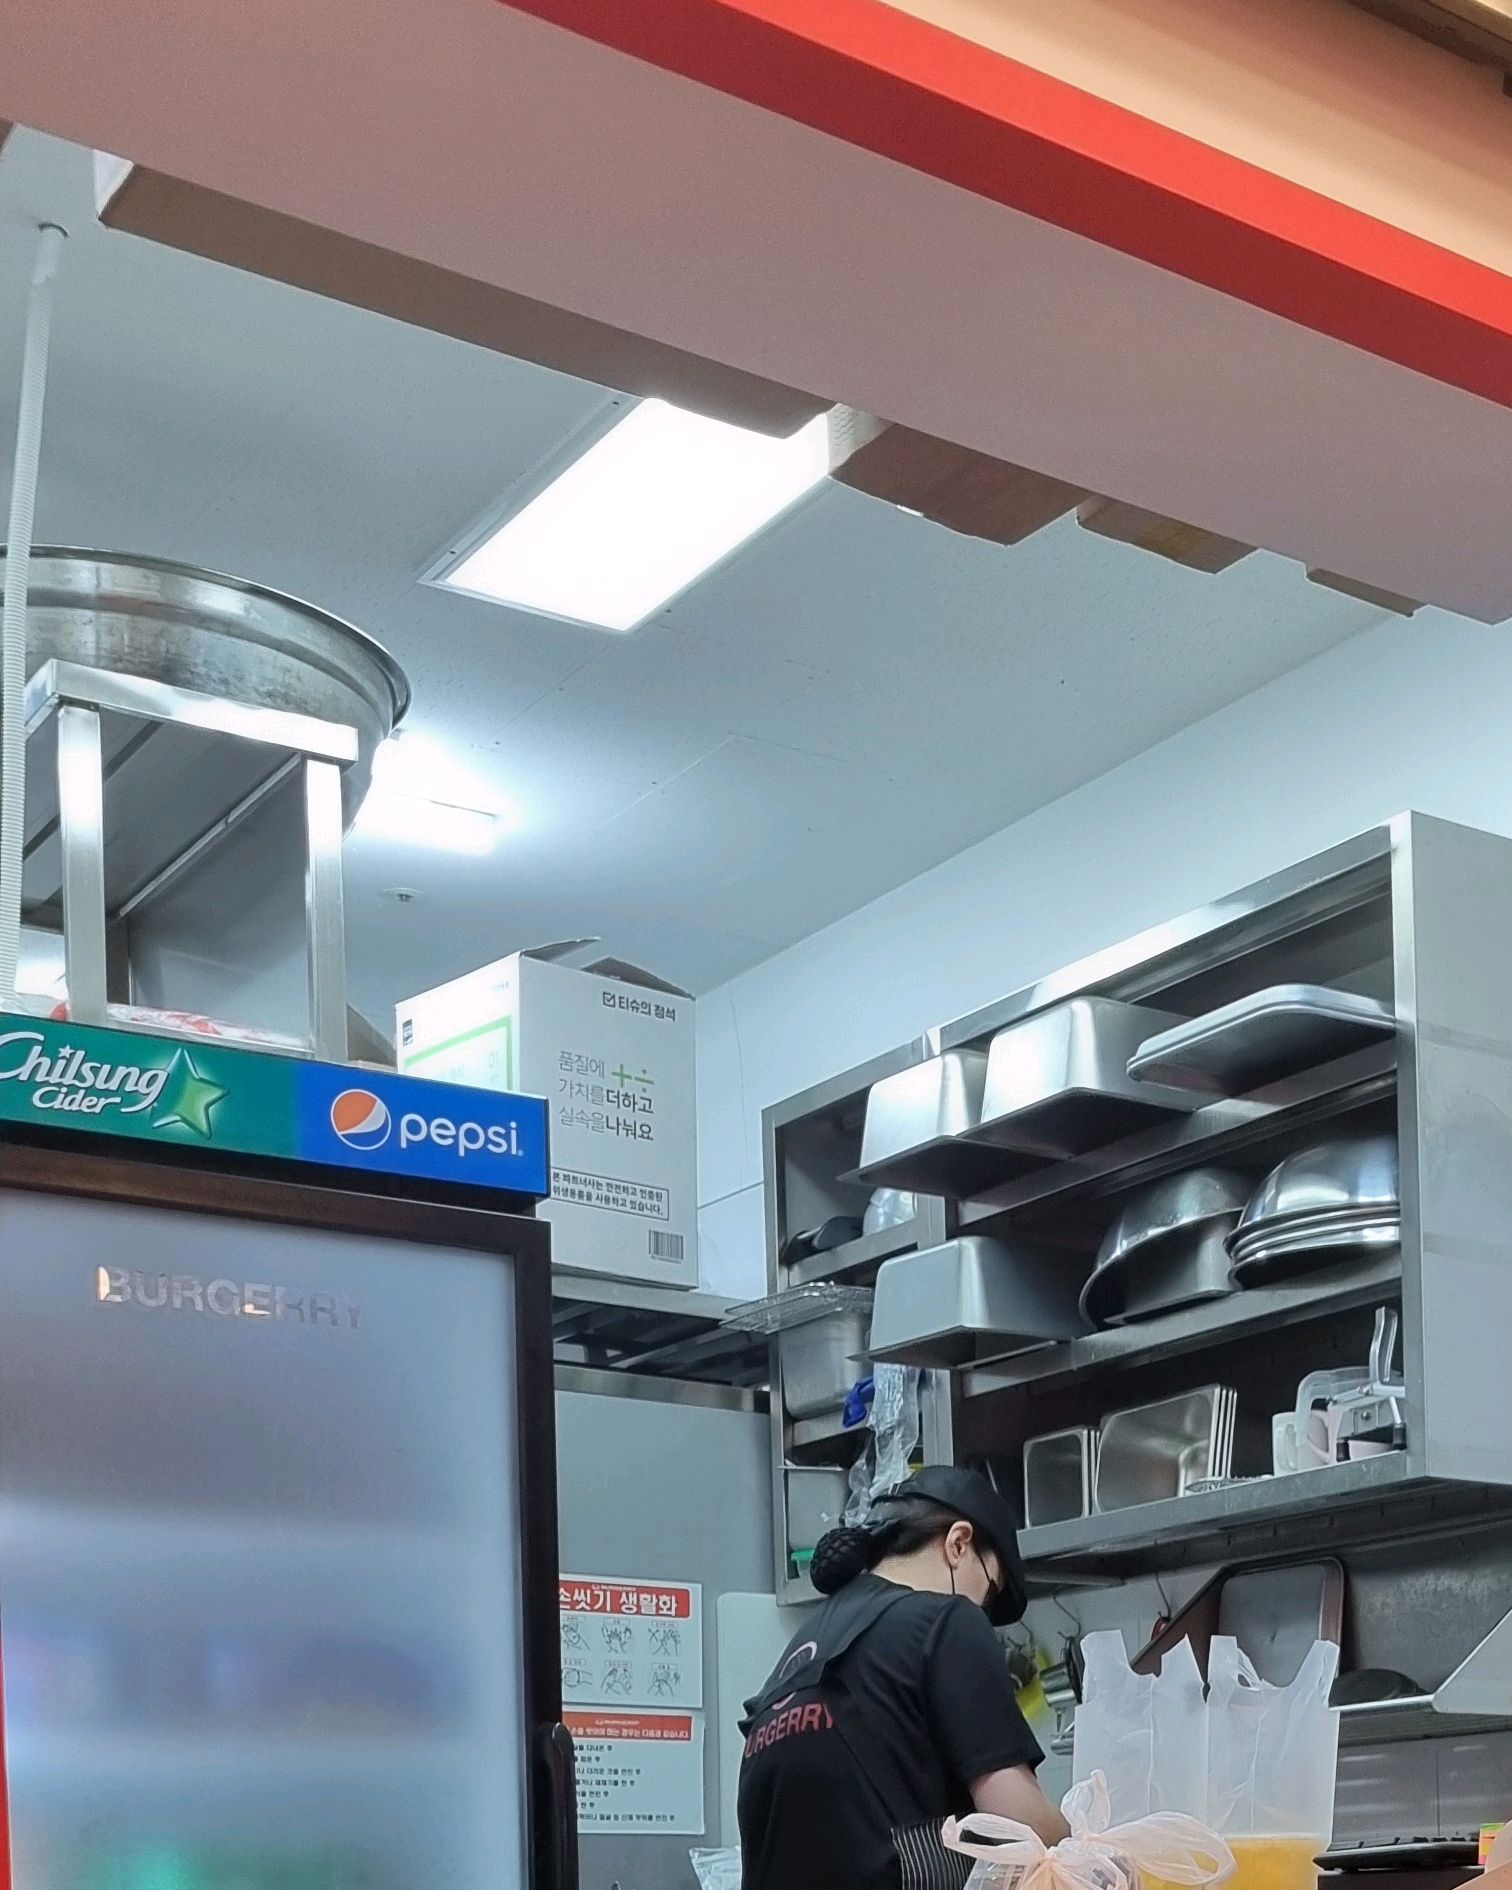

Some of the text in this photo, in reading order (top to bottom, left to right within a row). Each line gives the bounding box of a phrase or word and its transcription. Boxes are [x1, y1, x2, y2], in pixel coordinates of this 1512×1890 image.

[617, 995, 652, 1016] 티슈의
[558, 1050, 605, 1079] 품질에
[32, 1087, 122, 1114] Cider
[400, 1110, 519, 1158] pepsi
[97, 1264, 361, 1329] BURGERRY
[620, 1591, 678, 1617] 생활화
